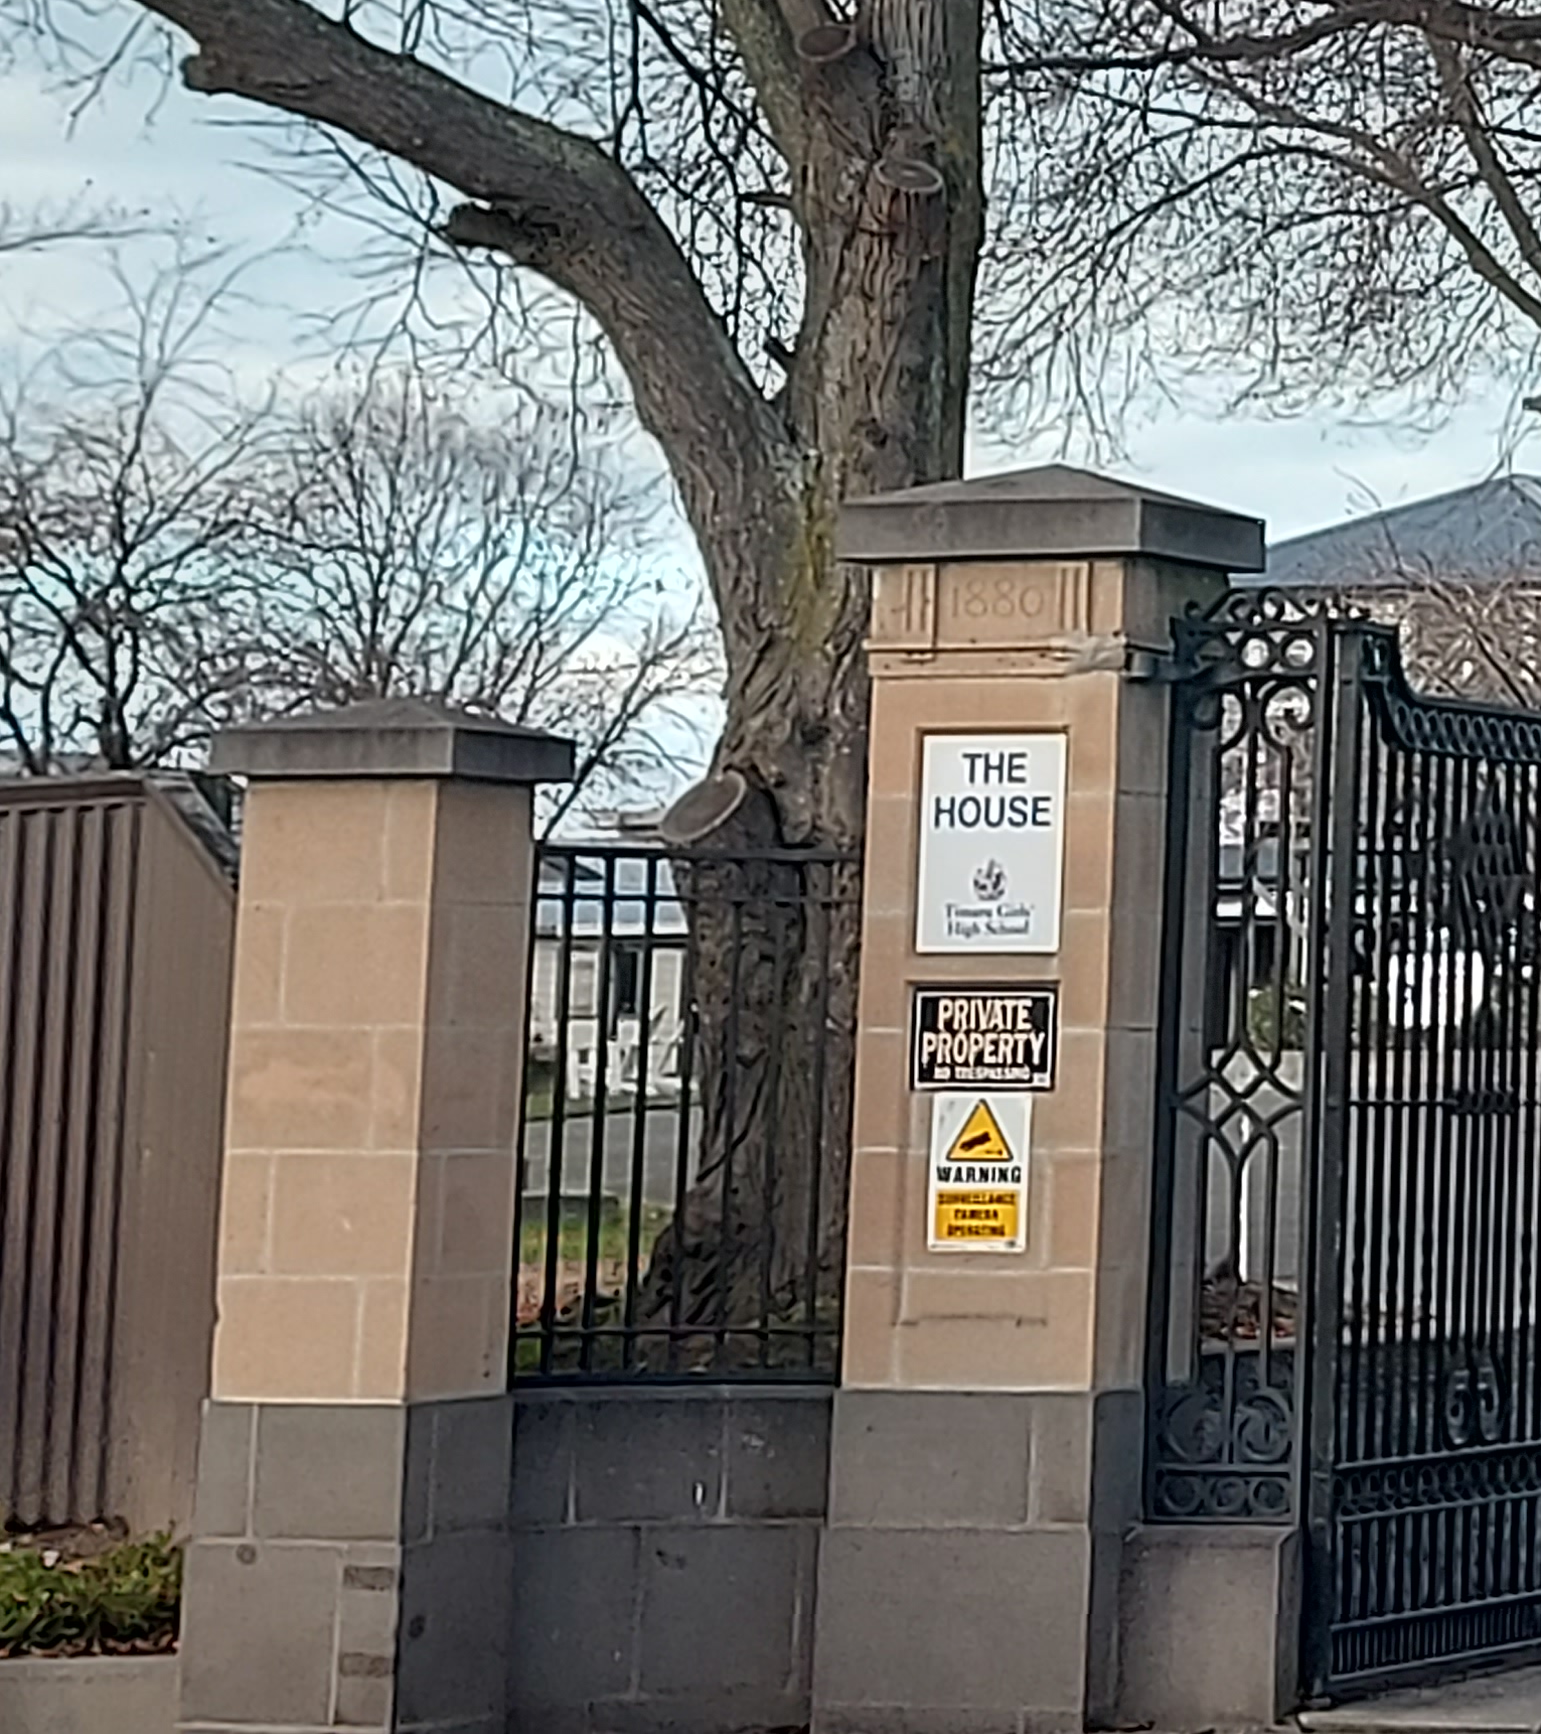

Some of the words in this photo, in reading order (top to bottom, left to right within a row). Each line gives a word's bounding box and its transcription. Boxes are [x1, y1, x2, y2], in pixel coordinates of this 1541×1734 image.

[950, 578, 1045, 619] 1880
[962, 752, 1028, 784] THE
[934, 795, 1052, 830] HOUSE
[947, 920, 980, 940] High
[937, 998, 1033, 1032] PRIVATE
[921, 1031, 1045, 1067] PROPERTY
[936, 1165, 1022, 1184] WARNING
